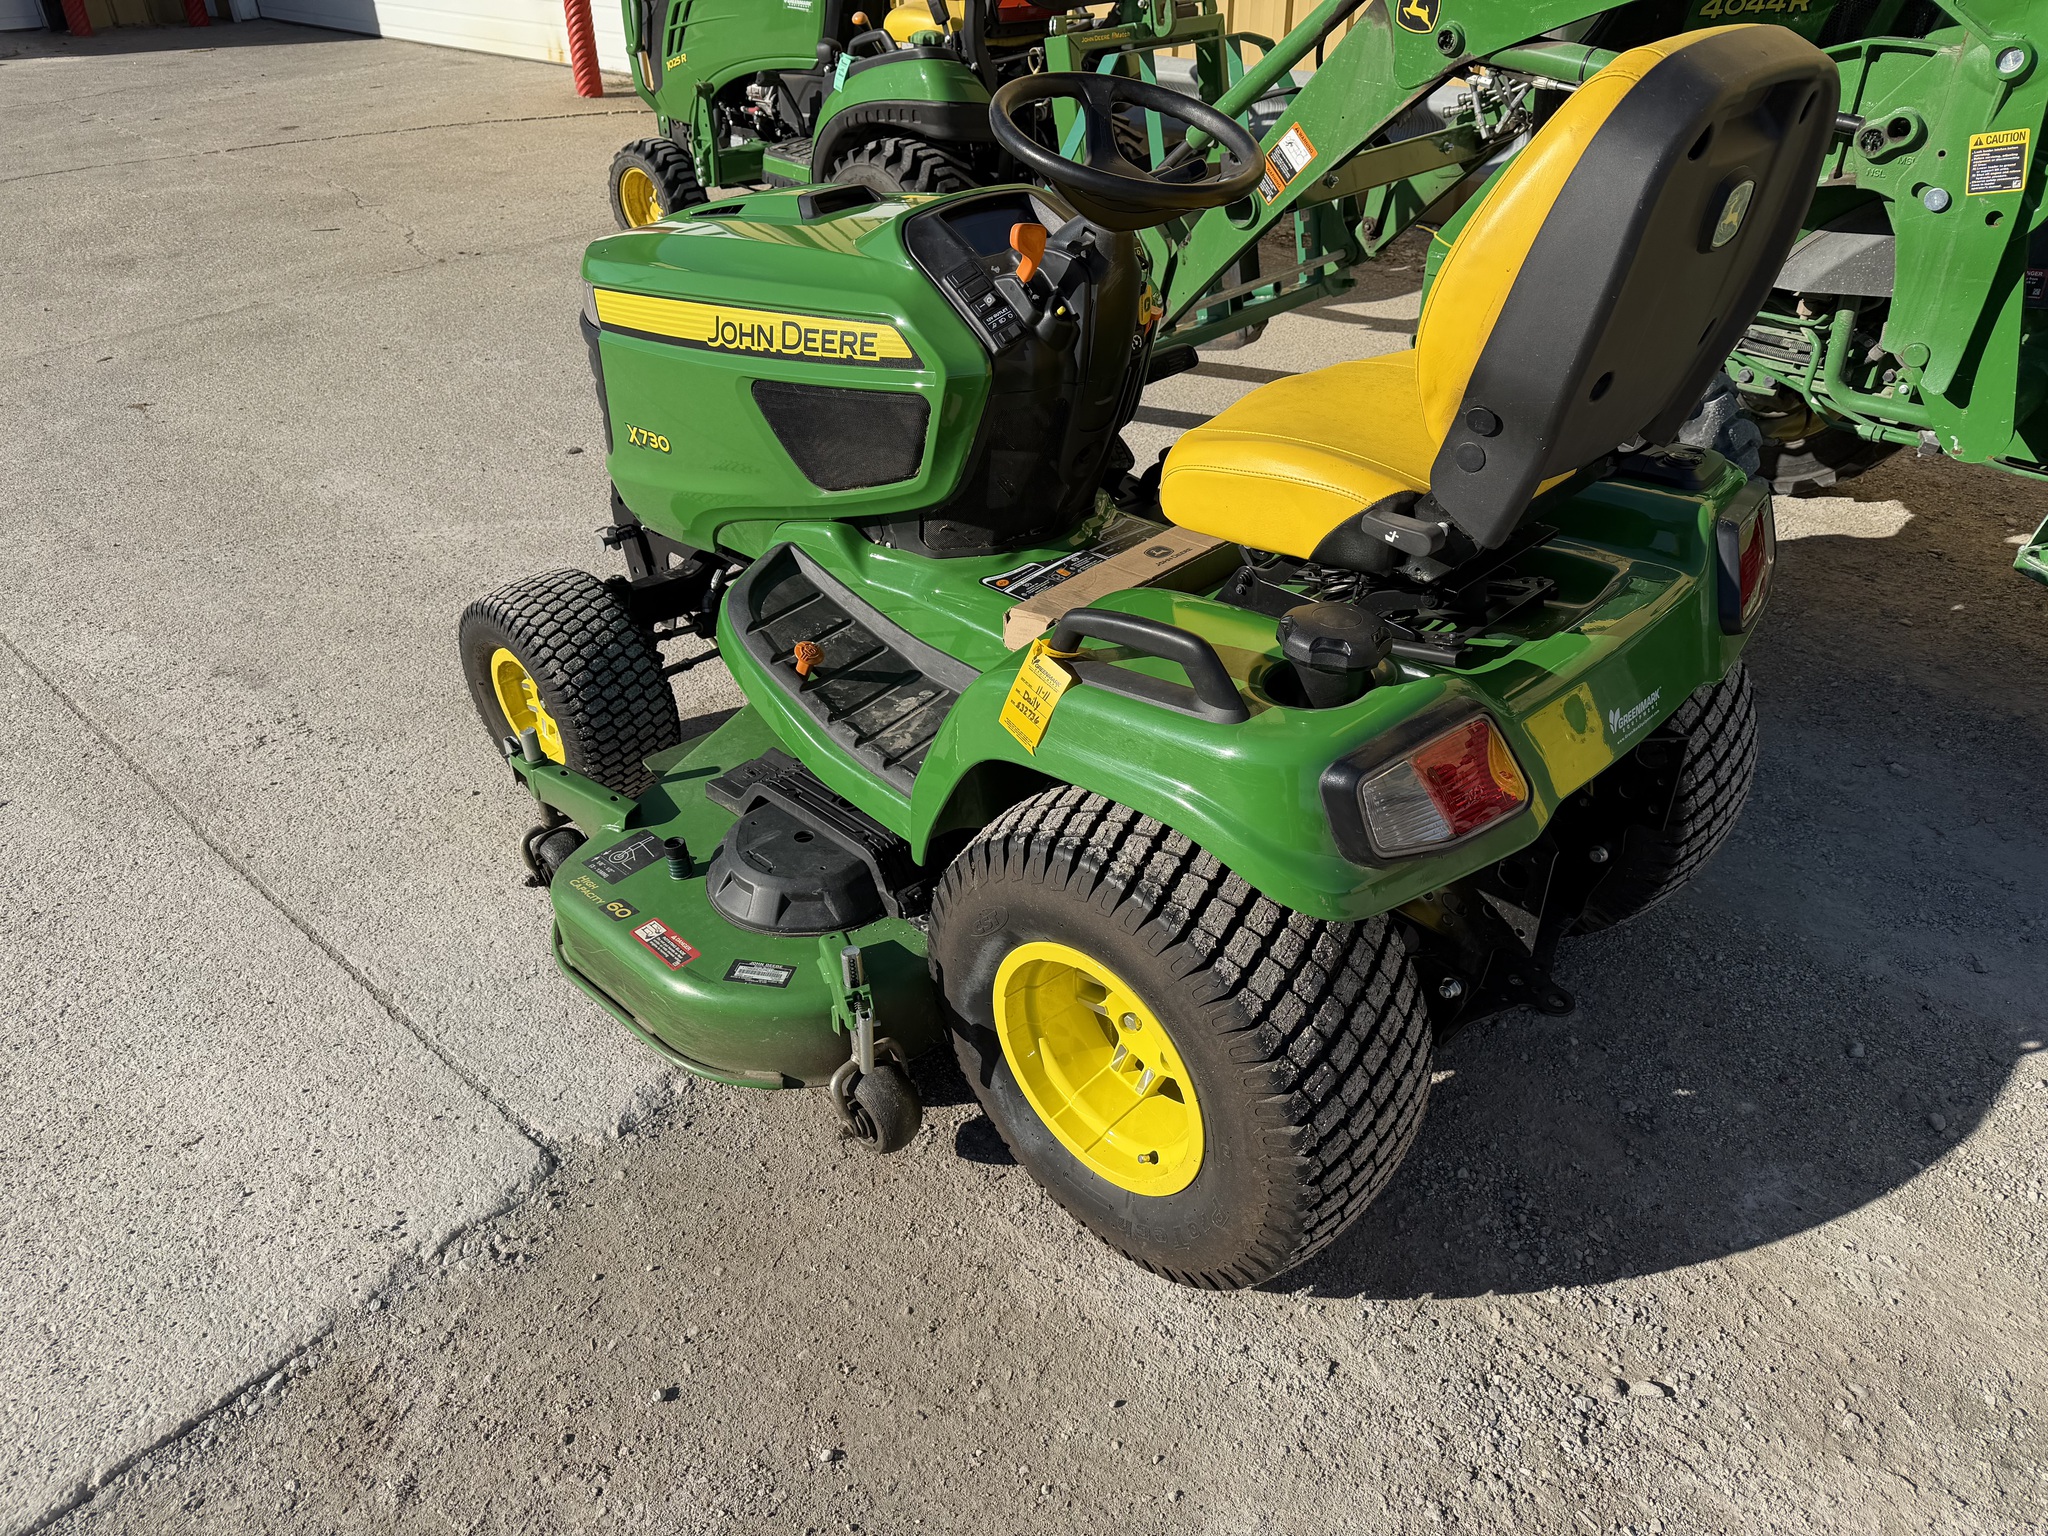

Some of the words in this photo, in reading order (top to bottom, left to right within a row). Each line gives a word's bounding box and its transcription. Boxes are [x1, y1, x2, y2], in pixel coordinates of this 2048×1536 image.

[1699, 0, 1809, 18] 4044R
[1298, 131, 1314, 154] WARNING
[1986, 131, 2026, 145] CAUTION
[1266, 167, 1281, 188] WARNING
[707, 316, 774, 349] JOHN
[781, 321, 878, 357] DEERE
[626, 423, 671, 453] X730
[1034, 663, 1062, 688] GREENMARK
[1618, 688, 1660, 729] GREENMARK
[577, 875, 599, 889] HIGH
[569, 879, 605, 904] CAPACITY
[606, 902, 632, 918] 60
[675, 937, 692, 951] DANGER
